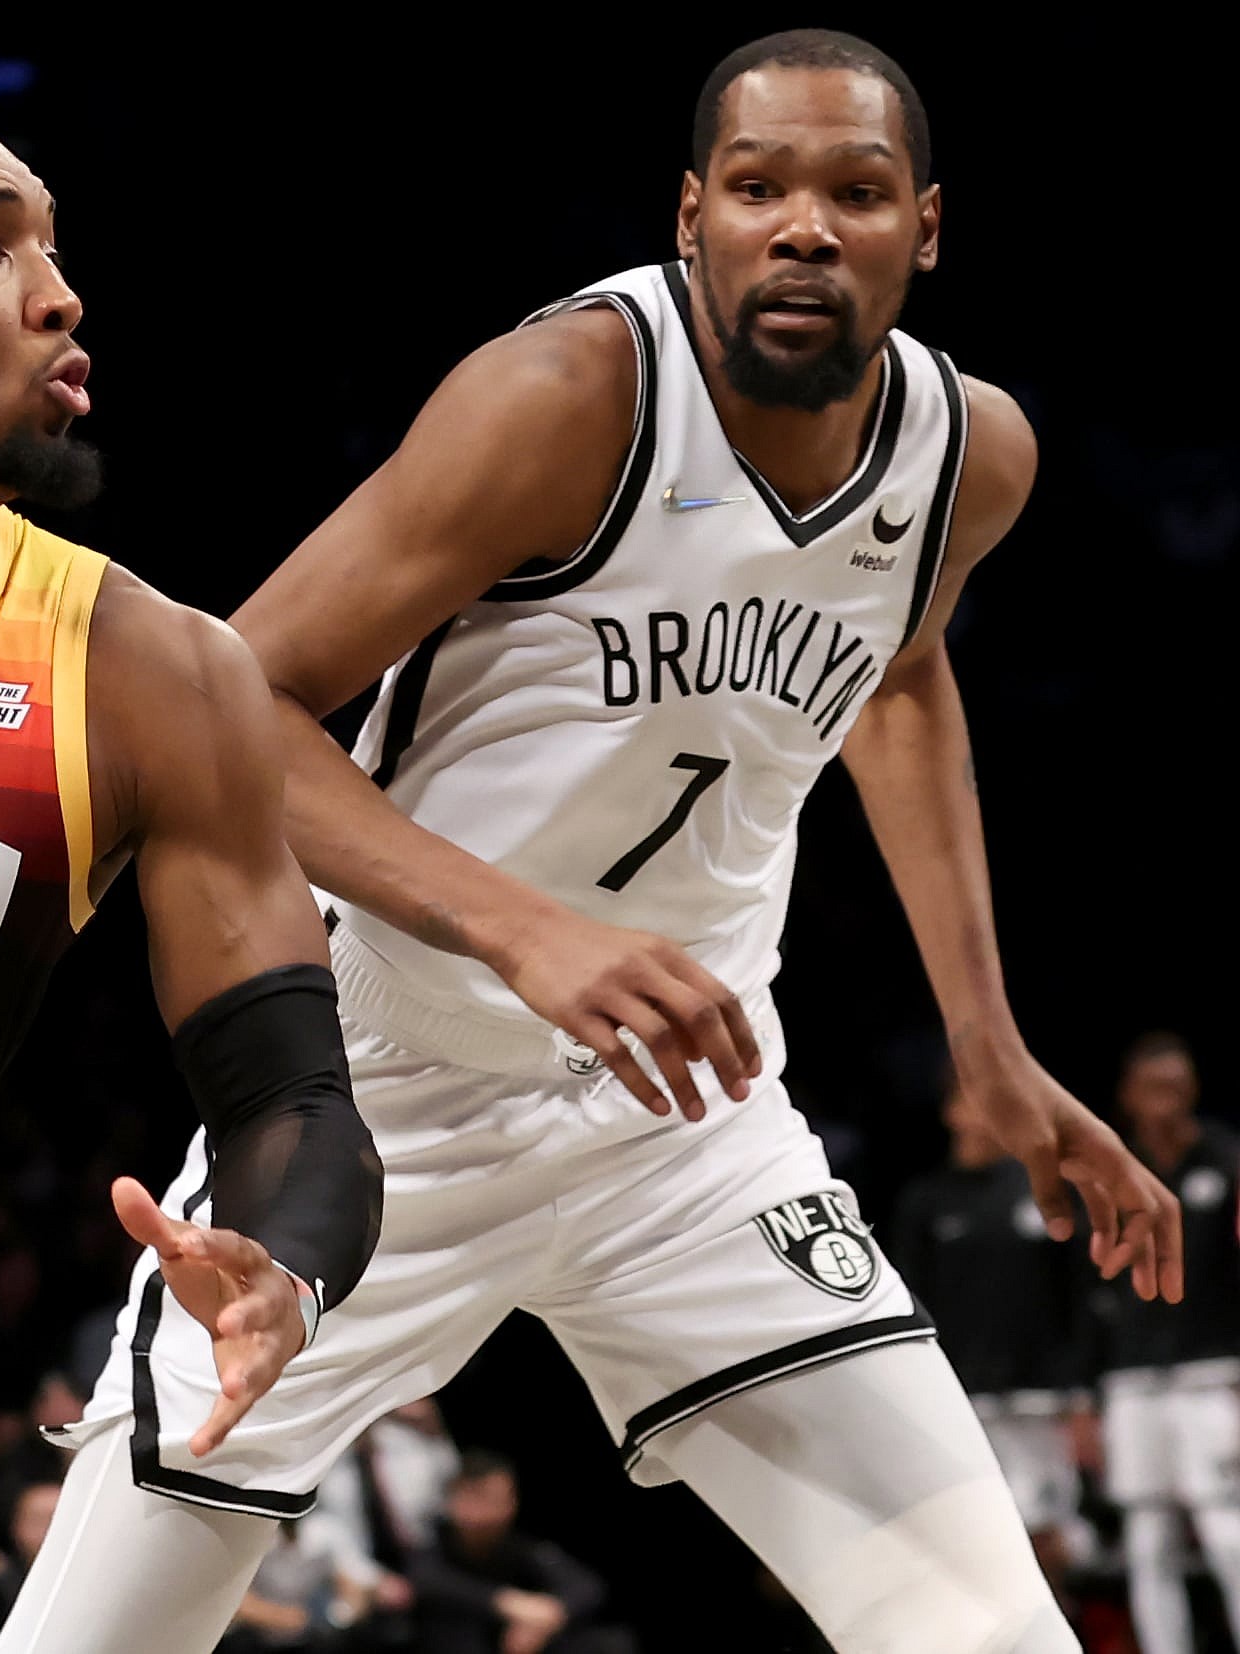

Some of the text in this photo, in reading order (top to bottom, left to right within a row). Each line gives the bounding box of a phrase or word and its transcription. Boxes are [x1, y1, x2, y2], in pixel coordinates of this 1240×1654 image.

[0, 687, 21, 698] THE
[591, 596, 877, 742] BROOKLYN
[595, 752, 731, 892] 7
[828, 1241, 857, 1280] B
